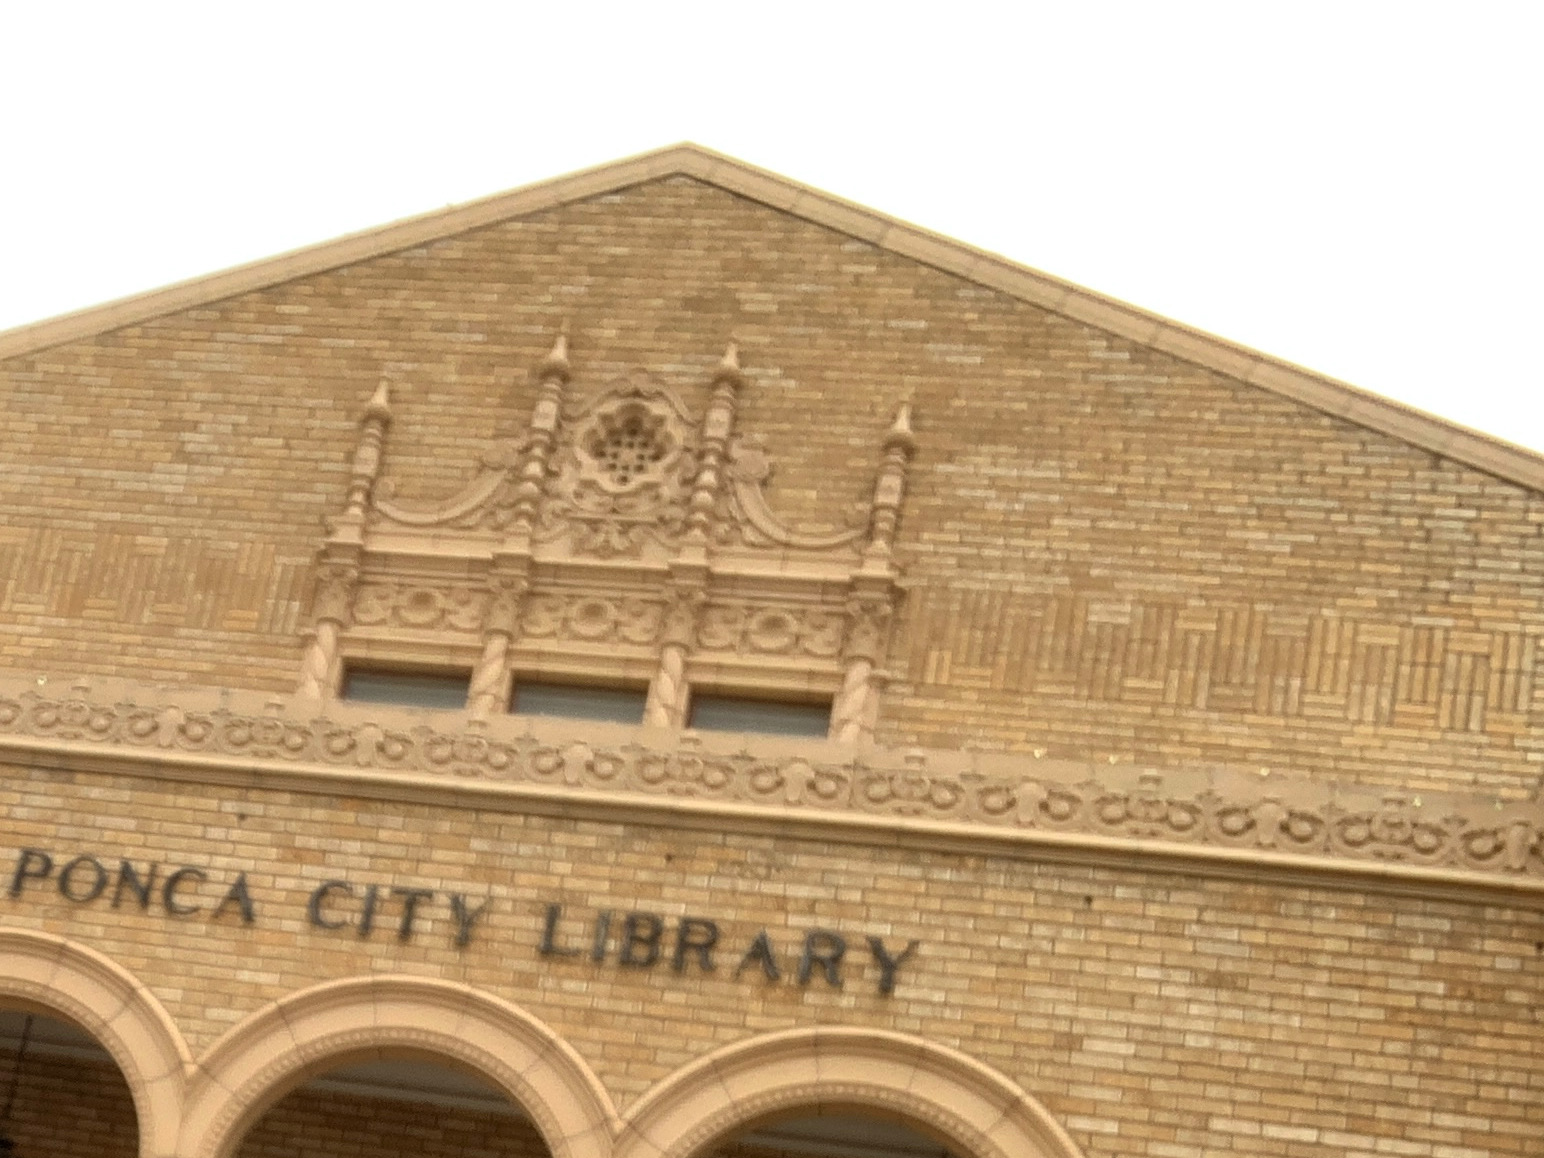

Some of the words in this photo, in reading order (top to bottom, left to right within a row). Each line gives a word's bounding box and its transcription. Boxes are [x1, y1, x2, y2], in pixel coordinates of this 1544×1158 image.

[8, 846, 255, 924] PONCA
[308, 879, 493, 947] CITY
[536, 902, 920, 998] LIBRARY
